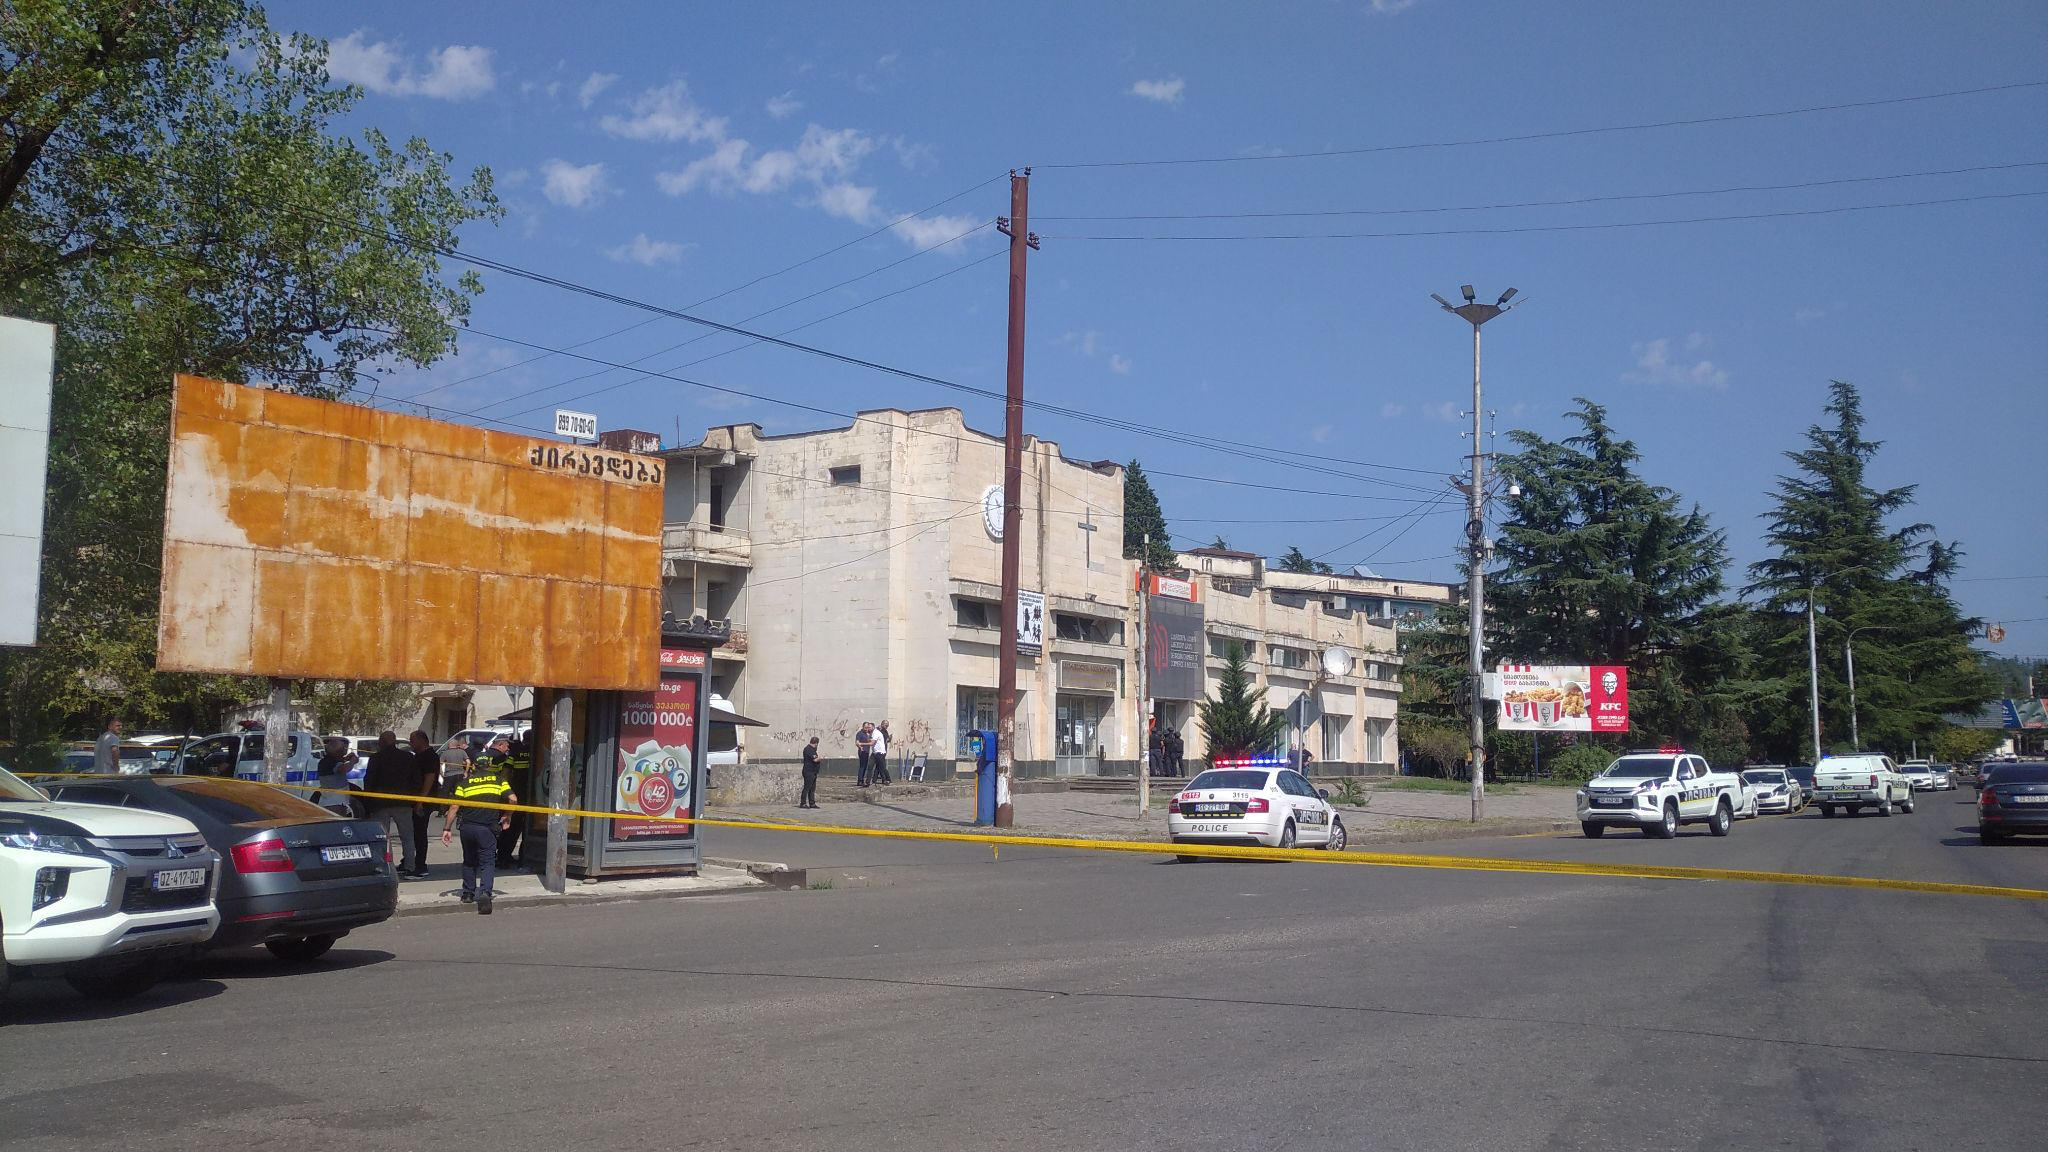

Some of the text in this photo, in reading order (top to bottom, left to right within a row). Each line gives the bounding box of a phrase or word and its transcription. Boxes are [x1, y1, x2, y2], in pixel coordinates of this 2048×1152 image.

[531, 446, 661, 484] ქირავდება
[1600, 702, 1621, 710] KFC
[652, 762, 660, 773] 3
[469, 775, 497, 783] POLICE
[626, 776, 633, 791] 1
[677, 773, 687, 787] 2
[1192, 824, 1229, 832] POLICE
